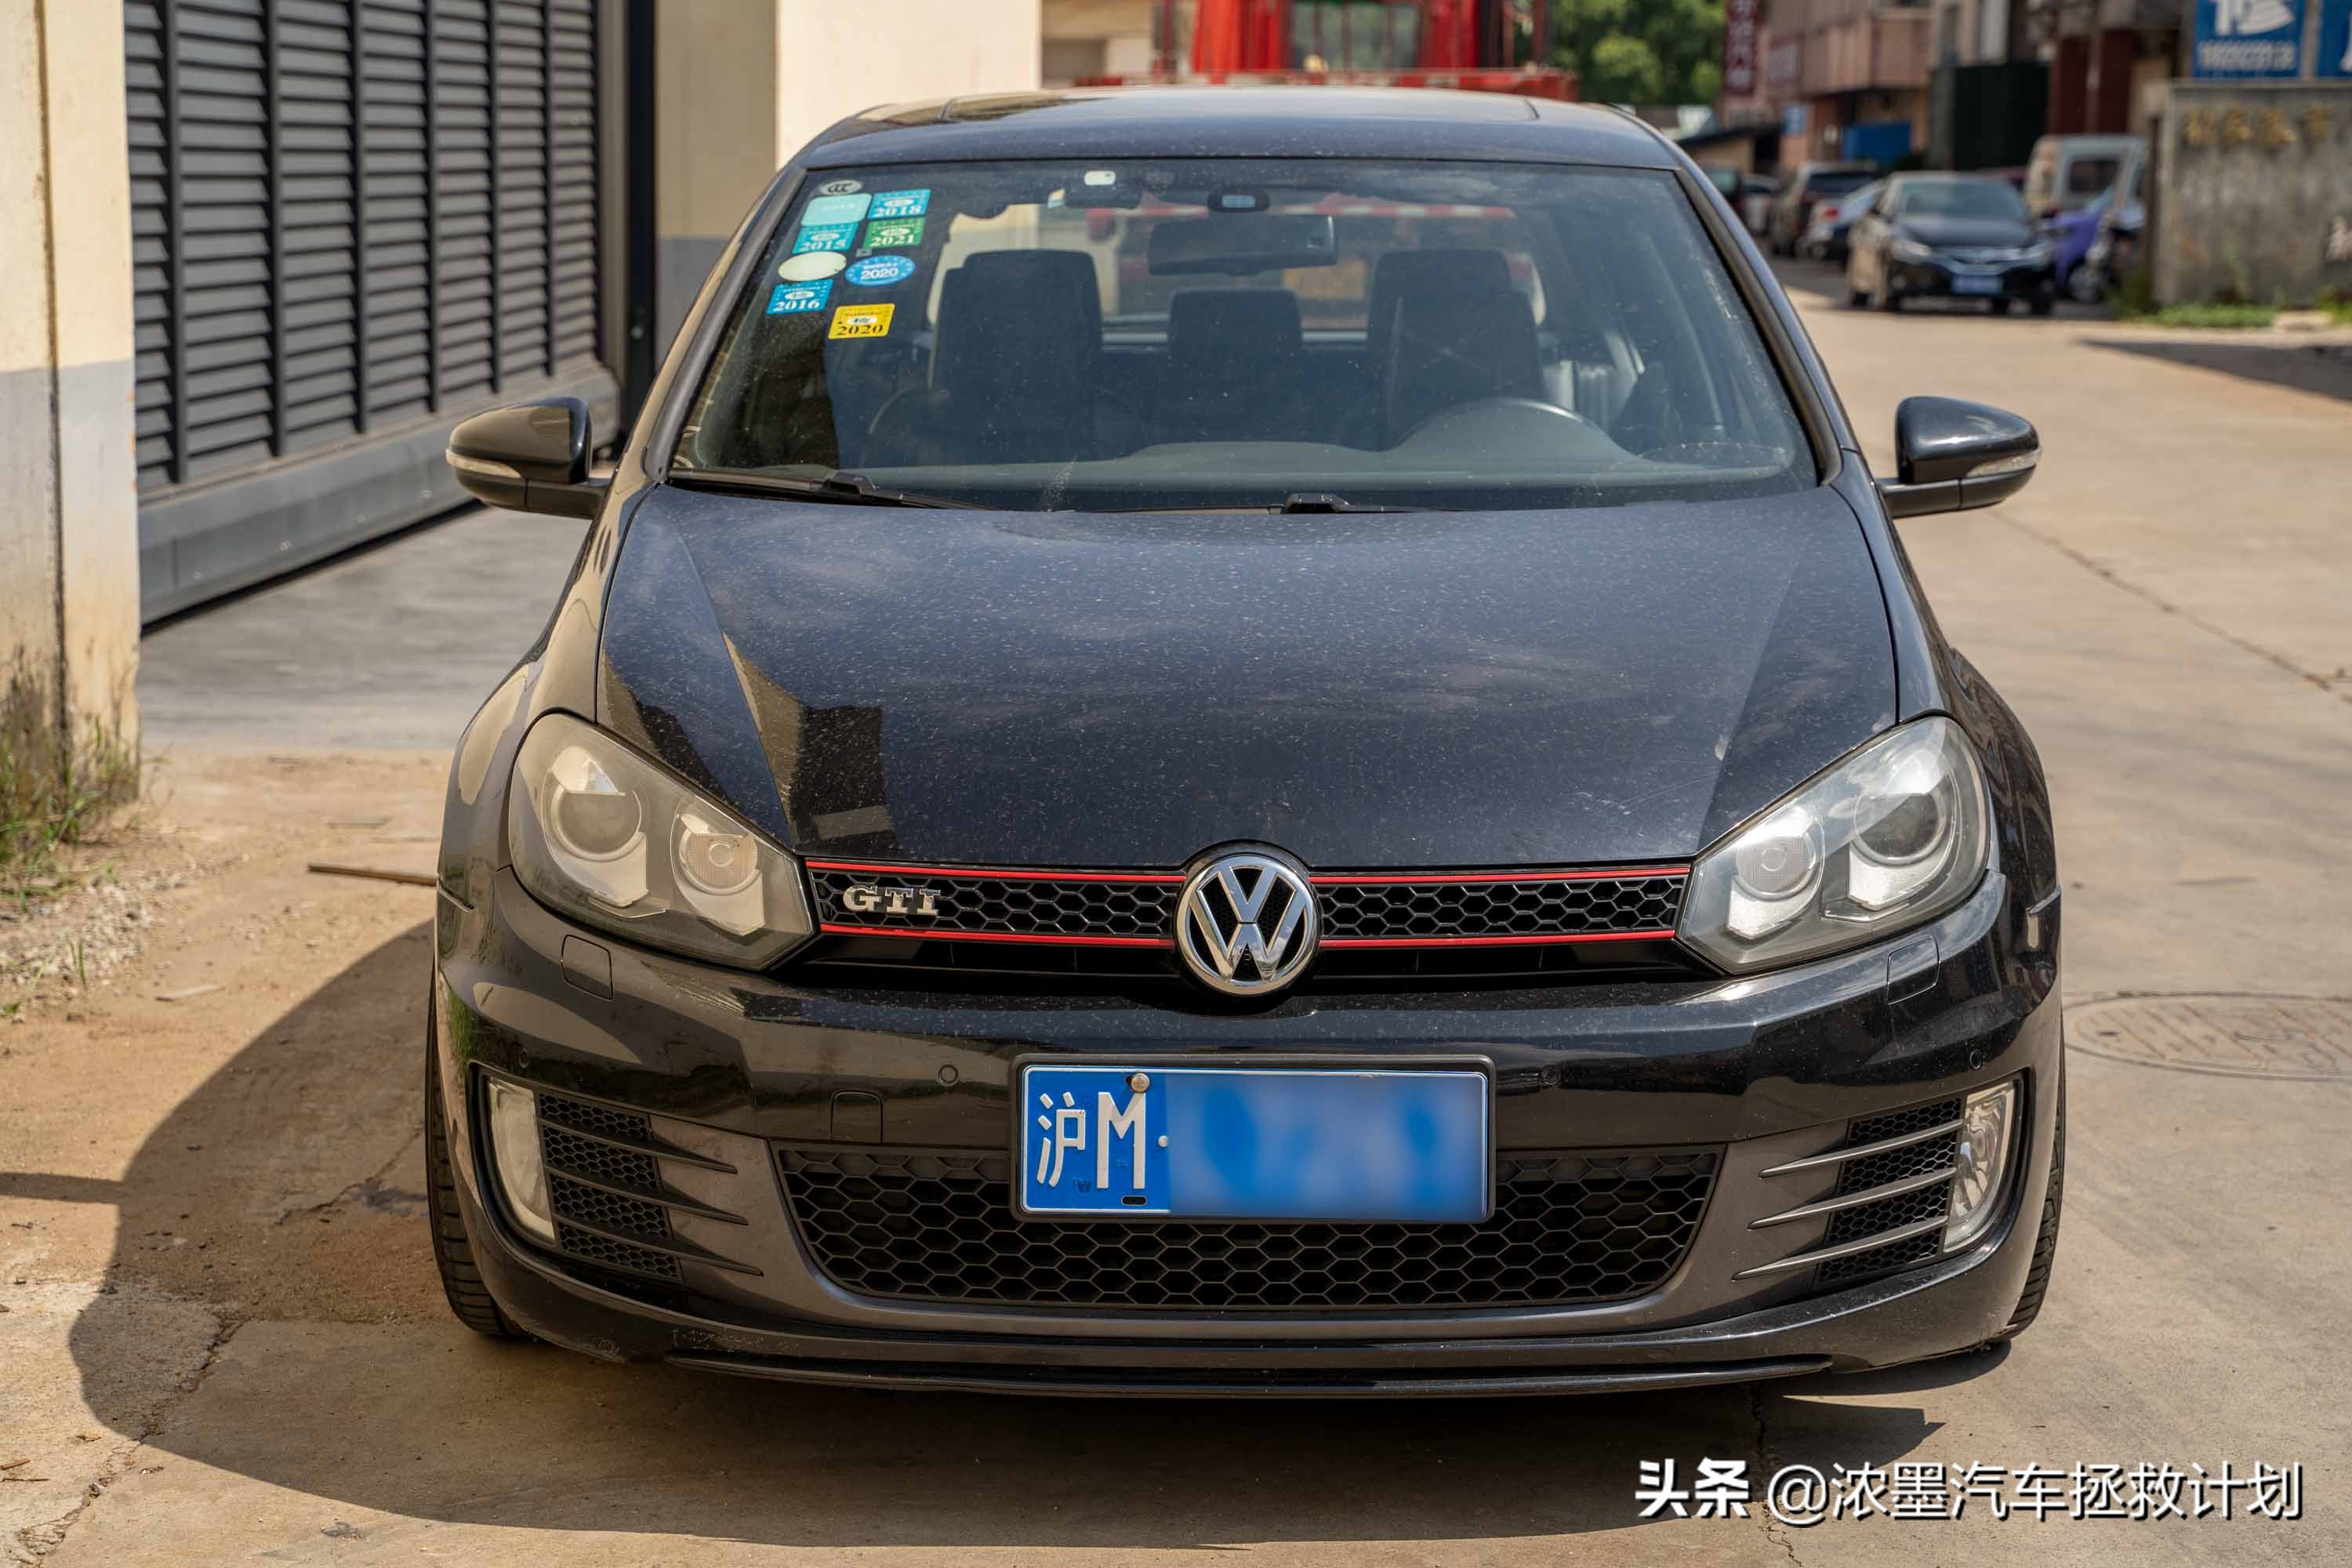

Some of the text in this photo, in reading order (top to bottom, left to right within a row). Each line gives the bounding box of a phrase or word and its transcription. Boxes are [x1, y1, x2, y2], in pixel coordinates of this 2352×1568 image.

[874, 205, 921, 217] 2018
[870, 234, 914, 247] 2021
[860, 267, 899, 280] 2020
[773, 299, 819, 311] 2016
[837, 325, 884, 336] 2020
[842, 885, 941, 916] GTI
